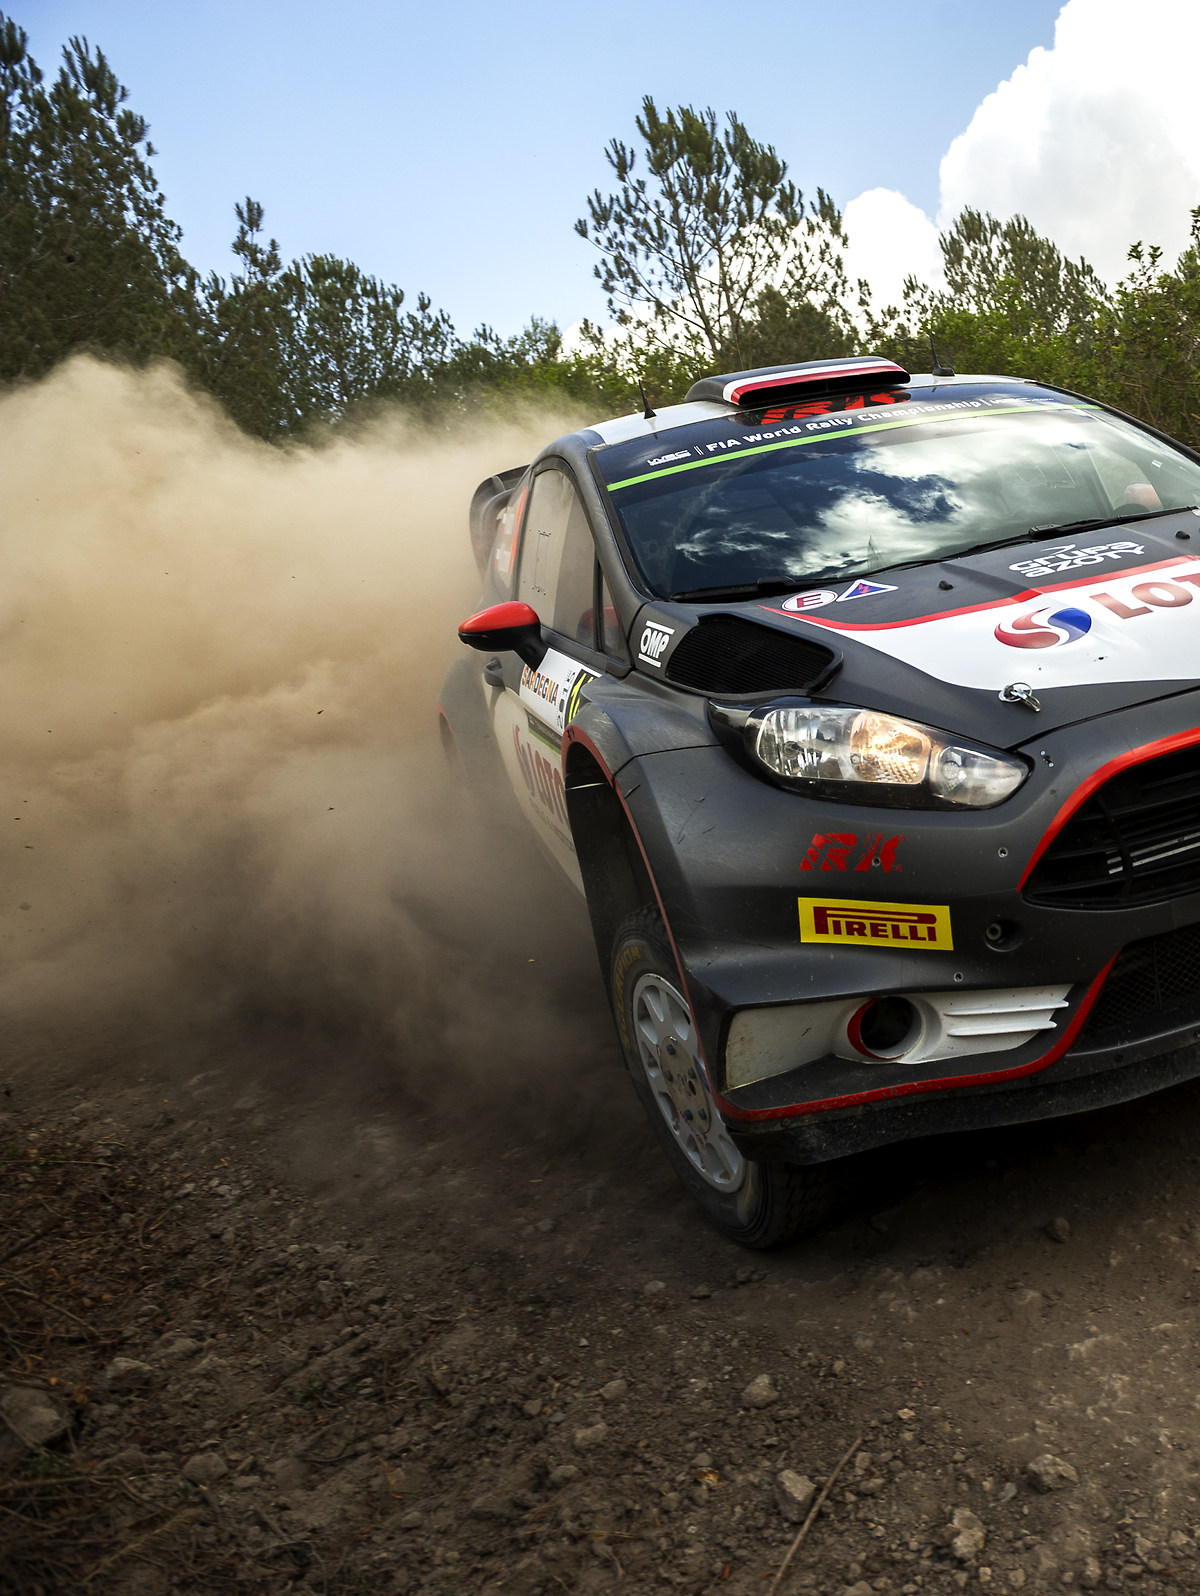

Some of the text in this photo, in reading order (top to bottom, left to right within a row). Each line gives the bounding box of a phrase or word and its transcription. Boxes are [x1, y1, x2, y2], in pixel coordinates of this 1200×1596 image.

[705, 438, 742, 452] FIA
[742, 425, 802, 443] World
[805, 416, 853, 432] Rally
[857, 398, 983, 421] Championship
[797, 593, 822, 609] E
[639, 628, 670, 660] OMP
[521, 665, 560, 707] SARDEGNA
[812, 905, 938, 943] PIRELLI
